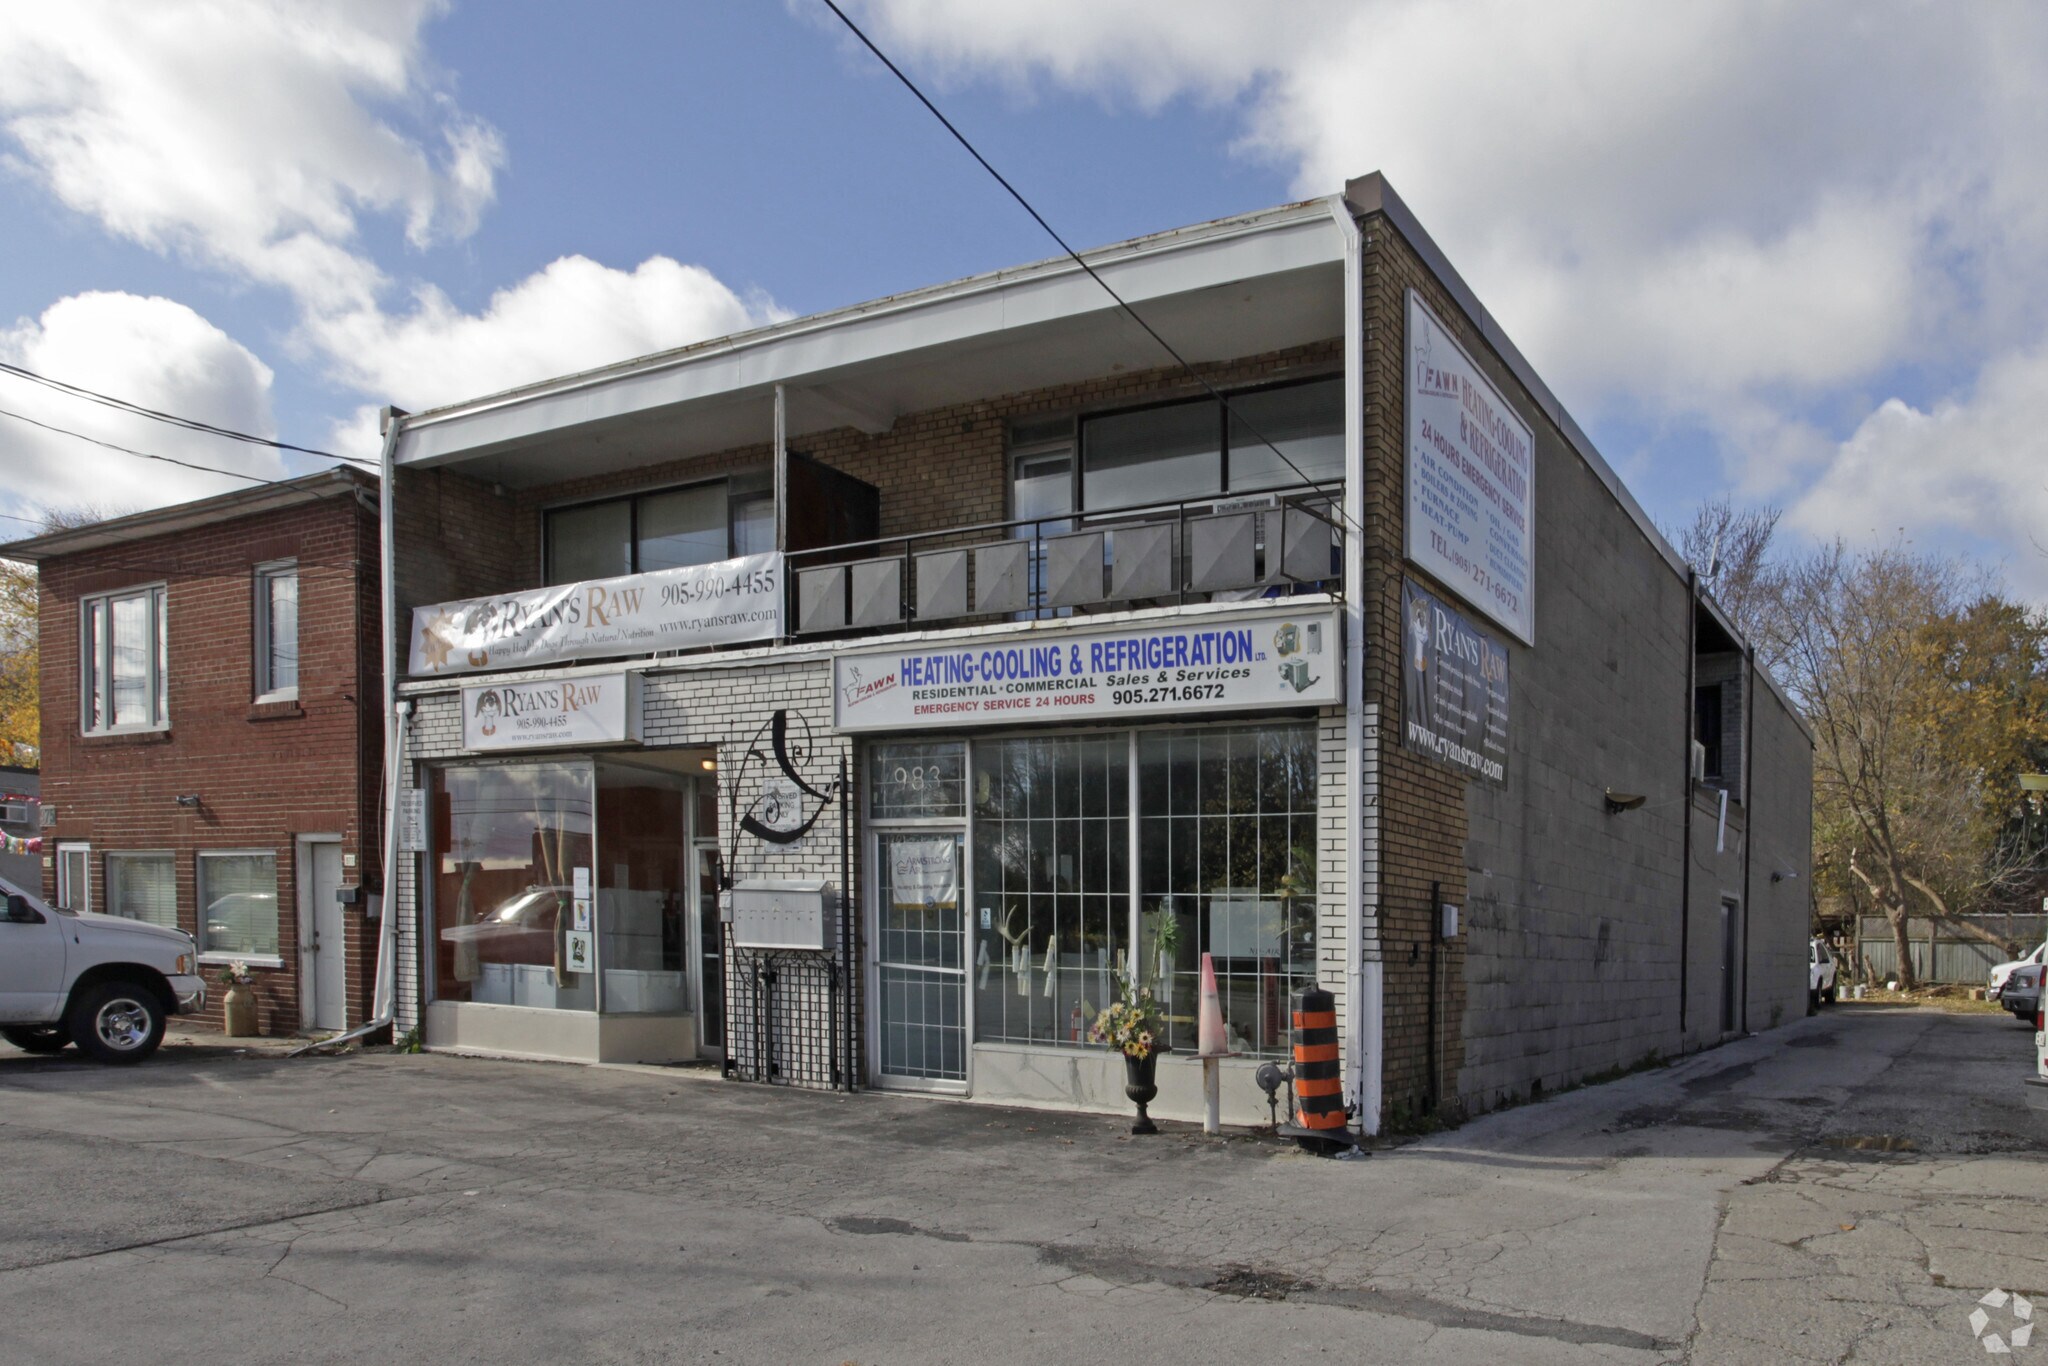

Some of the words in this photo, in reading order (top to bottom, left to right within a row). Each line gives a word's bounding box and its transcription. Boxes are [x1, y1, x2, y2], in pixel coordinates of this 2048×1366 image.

[1462, 375, 1527, 475] HEATING-COOLING
[1422, 419, 1432, 443] 24
[1434, 430, 1460, 469] HOURS
[1462, 456, 1501, 508] EMERGENCY
[1502, 497, 1525, 534] SERVICE
[1461, 411, 1468, 445] &
[1470, 421, 1527, 506] REFRIGERATION
[1421, 451, 1436, 471] AIR
[1438, 466, 1479, 509] CONDITION
[1421, 467, 1449, 498] BOILERS
[1457, 496, 1478, 522] ZONING
[1421, 484, 1460, 524] FURNACE
[1421, 501, 1470, 545] HEAT-PUMP
[1490, 513, 1502, 531] OIL
[661, 569, 775, 607] 905-990-4455
[1472, 564, 1518, 612] 271-6672
[498, 597, 581, 639] RYAN'S
[584, 586, 645, 628] RAW
[660, 609, 777, 632] www.ryansraw.com
[489, 645, 511, 657] Happy
[591, 628, 621, 643] Natural
[901, 645, 1062, 687] HEATING-COOLING
[1069, 644, 1083, 676] &
[1091, 630, 1253, 673] REFRIGERATION
[1434, 606, 1479, 666] RYAN'S
[1479, 636, 1506, 683] RAW
[502, 688, 559, 717] RYAN'S
[561, 682, 602, 712] RAW
[856, 672, 895, 698] FAWN
[913, 685, 997, 700] RESIDENTIAL
[1006, 677, 1097, 694] COMMERCIAL
[1106, 673, 1150, 687] Sales
[1157, 671, 1168, 683] &
[1176, 667, 1251, 682] Services
[1112, 684, 1225, 705] 905.271.6672
[516, 715, 567, 730] 905-990-4455
[914, 701, 980, 715] EMERGENCY
[983, 697, 1031, 711] SERVICE
[1035, 696, 1050, 707] 24
[1054, 693, 1096, 706] HOURS
[512, 730, 573, 742] www.ryansraw.com
[1408, 721, 1503, 781] www.ryansraw.com
[895, 765, 940, 790] 983
[769, 801, 795, 809] PAKING
